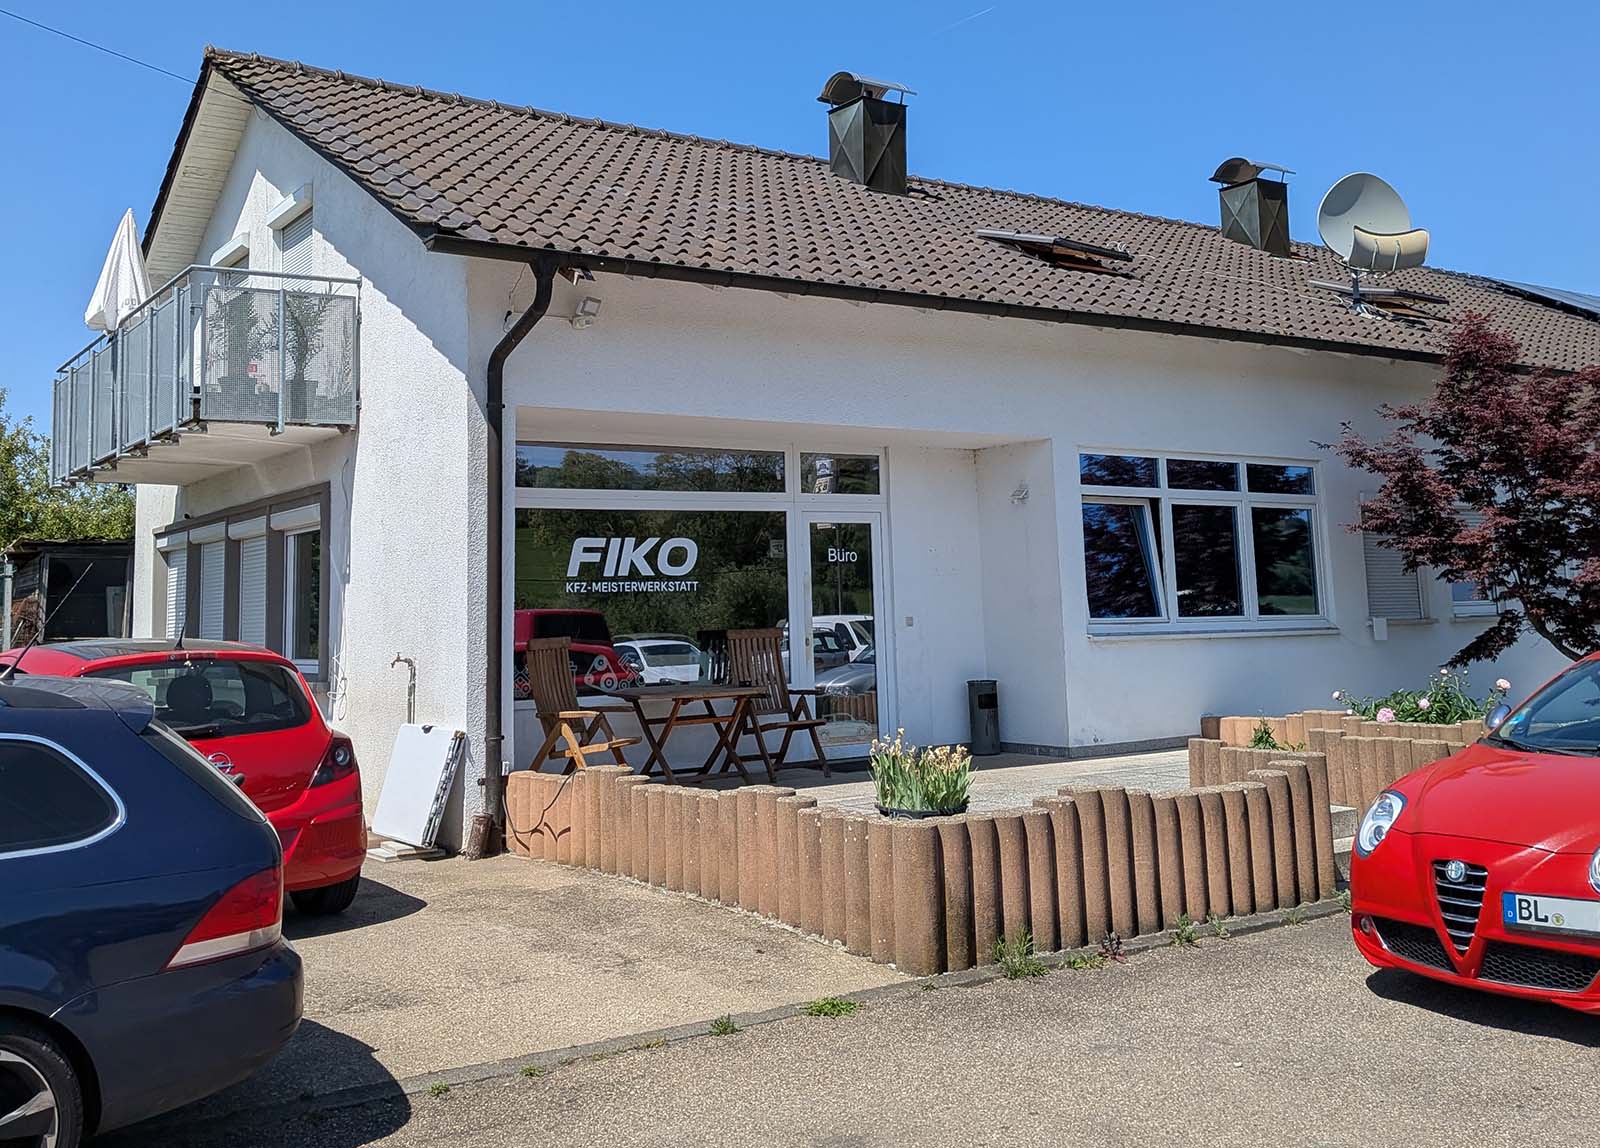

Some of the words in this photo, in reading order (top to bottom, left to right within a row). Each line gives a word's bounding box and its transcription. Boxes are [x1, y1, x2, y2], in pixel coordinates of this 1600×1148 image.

[566, 537, 698, 577] FIKO
[828, 548, 858, 563] Büro
[566, 581, 699, 593] KFZ-MEISTERWERKSTATT
[1517, 898, 1549, 923] BL
